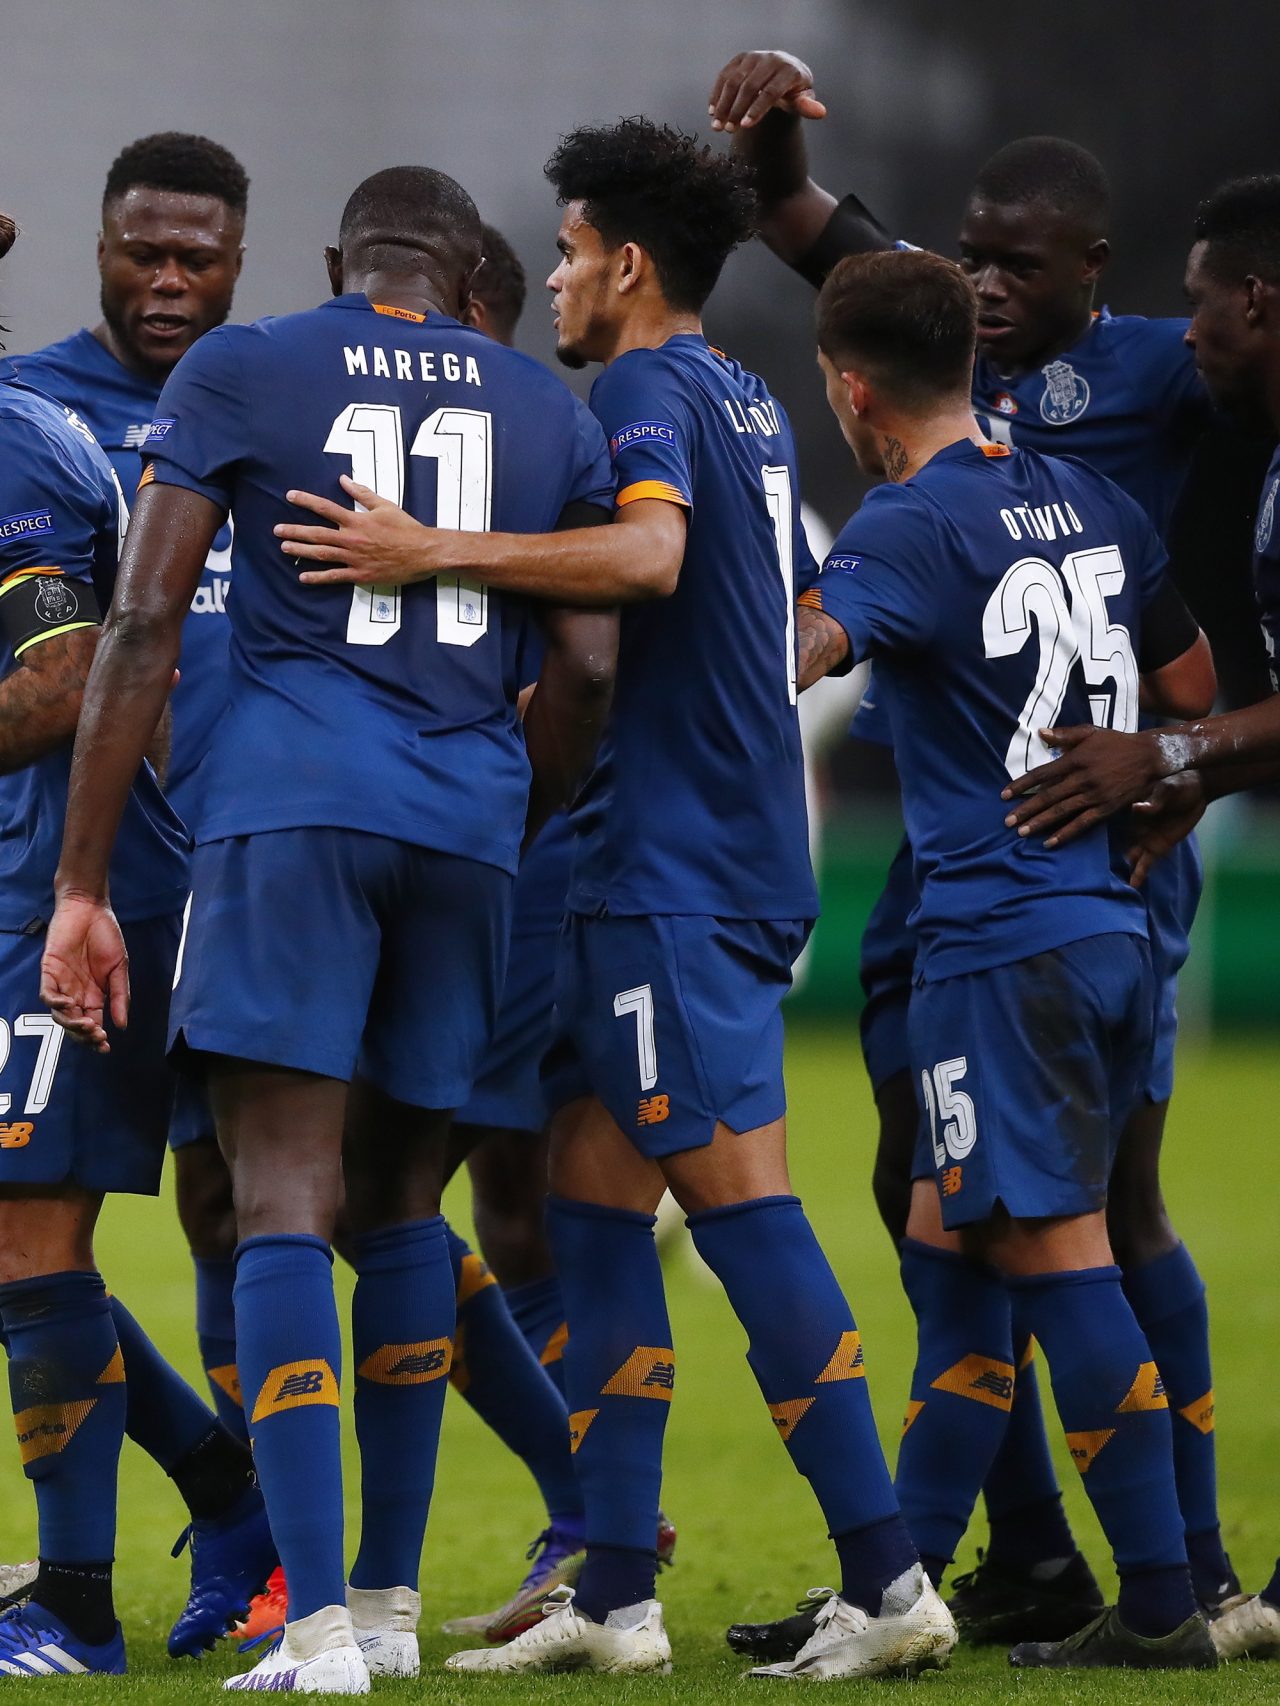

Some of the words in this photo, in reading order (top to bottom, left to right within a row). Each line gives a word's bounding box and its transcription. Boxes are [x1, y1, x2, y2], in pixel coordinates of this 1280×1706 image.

[394, 309, 417, 320] Porto
[342, 345, 482, 387] MAREGA
[618, 426, 675, 446] RESPECT
[322, 402, 493, 647] 11
[982, 544, 1140, 782] 25
[613, 983, 658, 1092] 7
